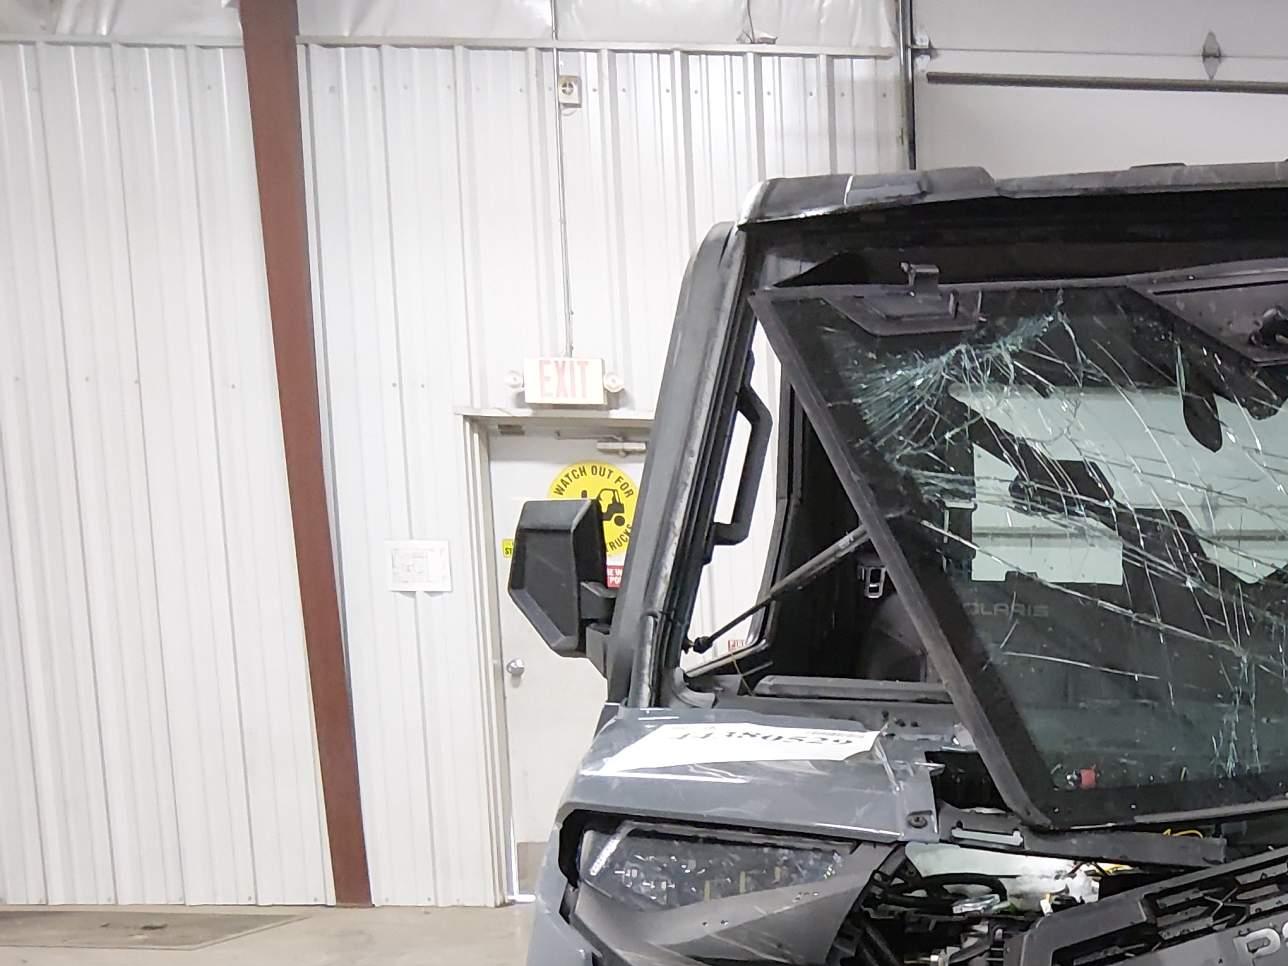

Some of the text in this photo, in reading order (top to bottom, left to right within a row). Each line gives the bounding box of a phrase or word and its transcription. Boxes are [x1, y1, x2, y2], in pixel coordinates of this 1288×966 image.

[539, 359, 588, 399] EXIT
[554, 465, 634, 498] WATCH OUT FOR
[606, 523, 632, 552] RUCK
[962, 602, 1049, 617] OLARIS
